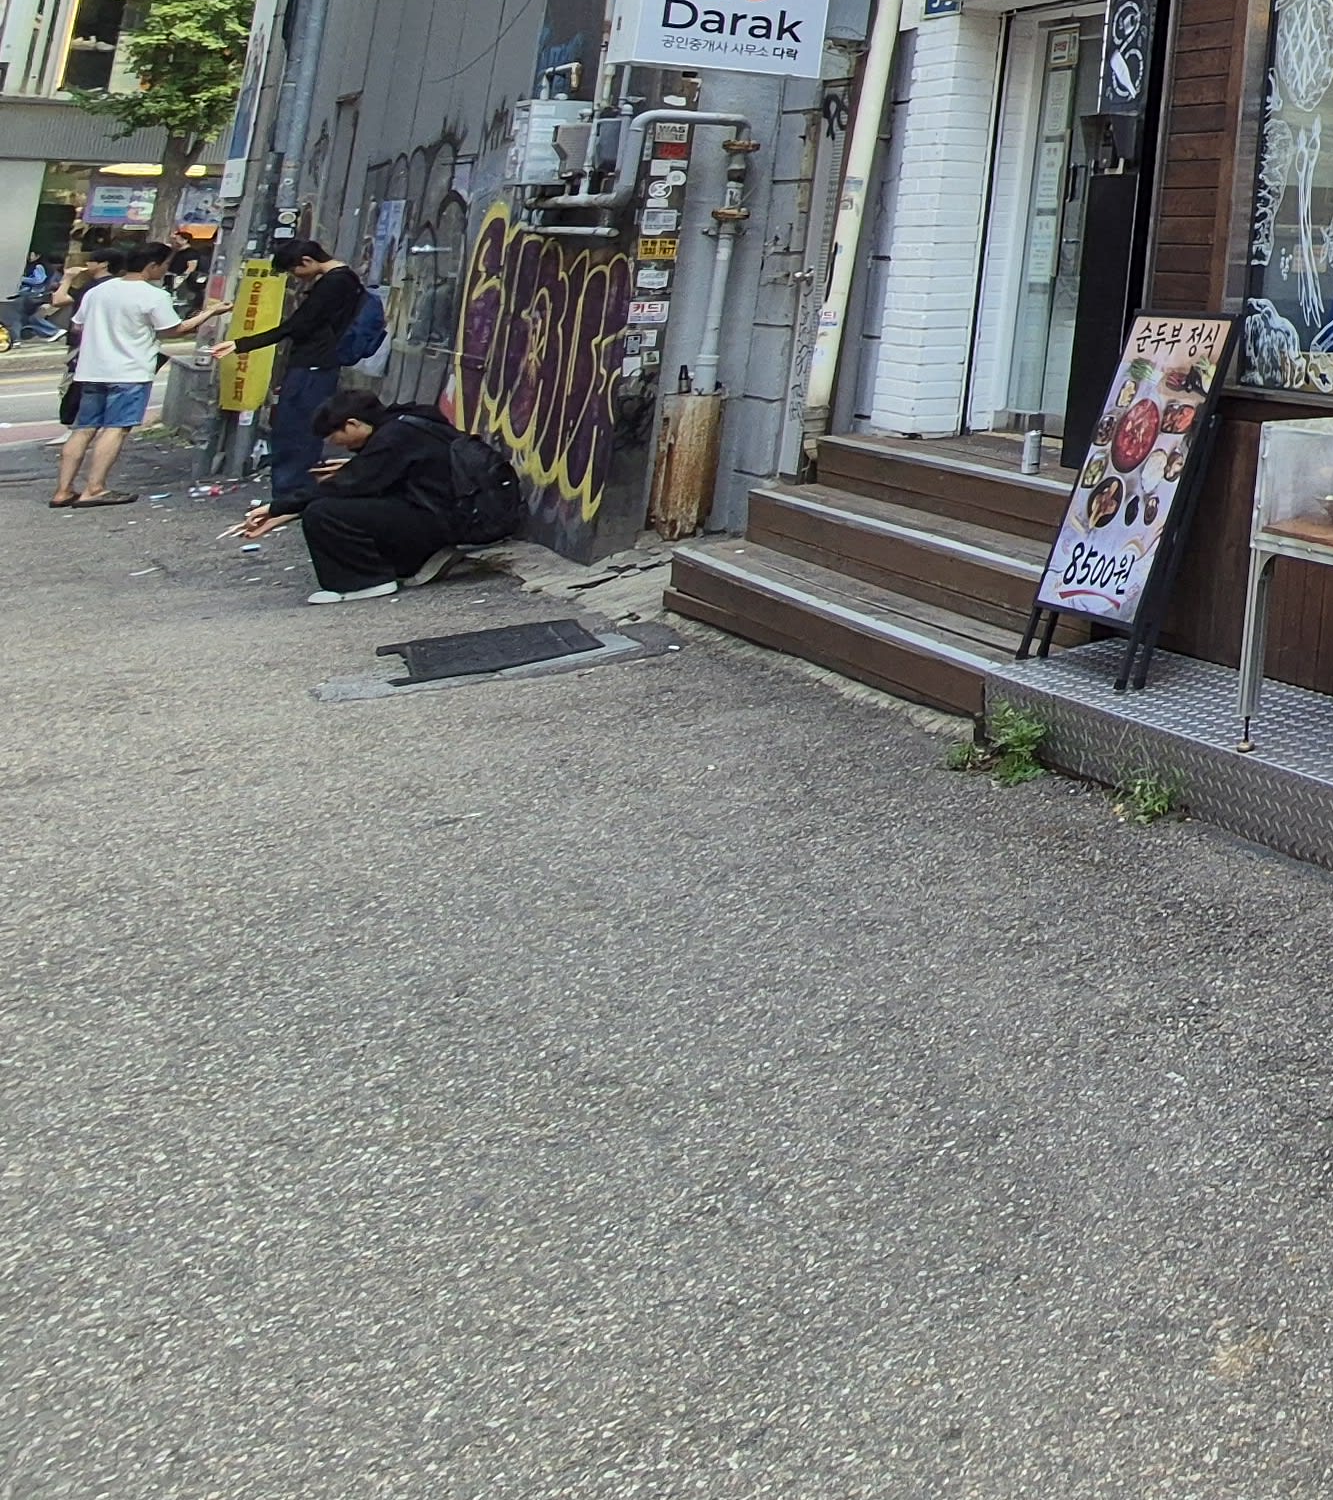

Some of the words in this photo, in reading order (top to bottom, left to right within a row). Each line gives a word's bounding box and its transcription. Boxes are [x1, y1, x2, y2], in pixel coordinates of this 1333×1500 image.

[661, 34, 728, 54] 공인중개사
[730, 43, 768, 57] 사무소
[772, 46, 798, 61] 다락
[1136, 321, 1183, 356] 순두부
[1185, 323, 1221, 360] 정식
[1062, 541, 1136, 596] 8500원
